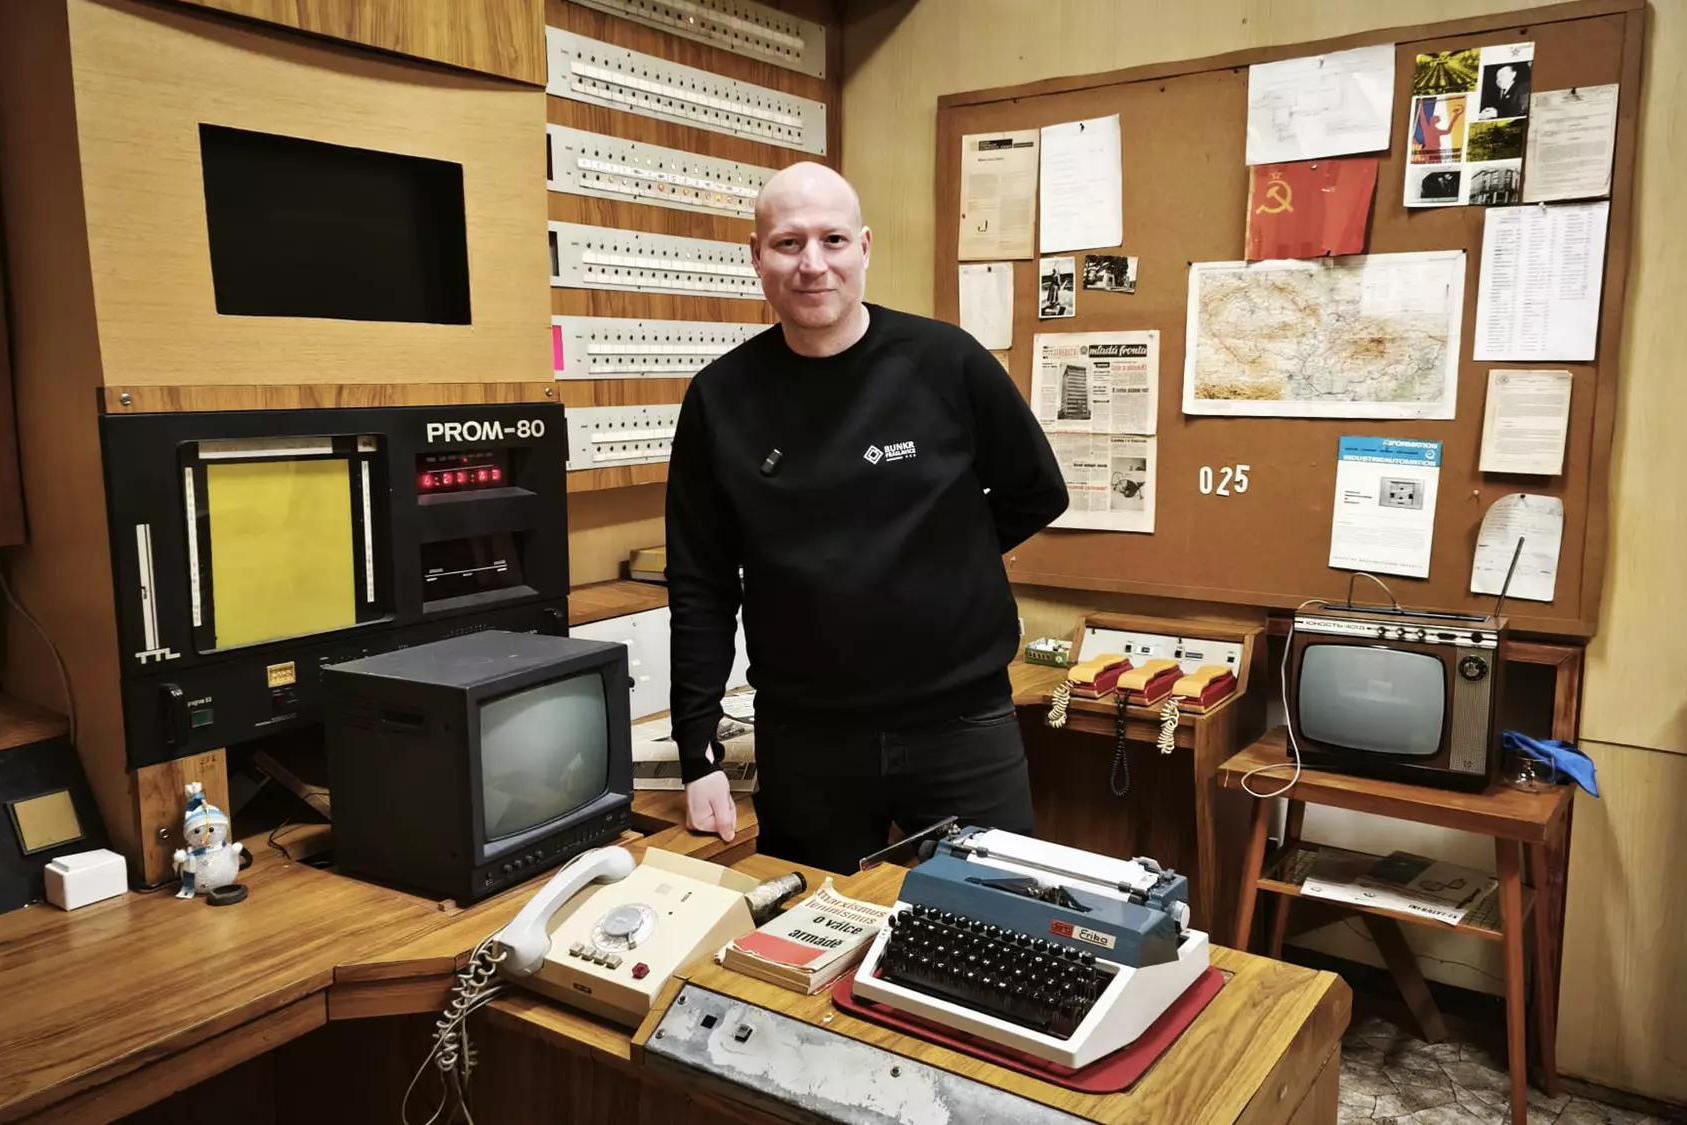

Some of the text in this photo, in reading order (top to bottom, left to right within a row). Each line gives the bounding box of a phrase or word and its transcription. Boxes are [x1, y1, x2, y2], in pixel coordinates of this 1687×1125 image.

[426, 419, 545, 443] PROM-80
[884, 441, 915, 453] BUNKR
[1199, 464, 1251, 497] 025
[134, 647, 181, 664] TTL
[818, 889, 887, 919] marxismus
[812, 915, 863, 936] o válce
[788, 928, 842, 949] armádě
[1079, 928, 1108, 946] Erika
